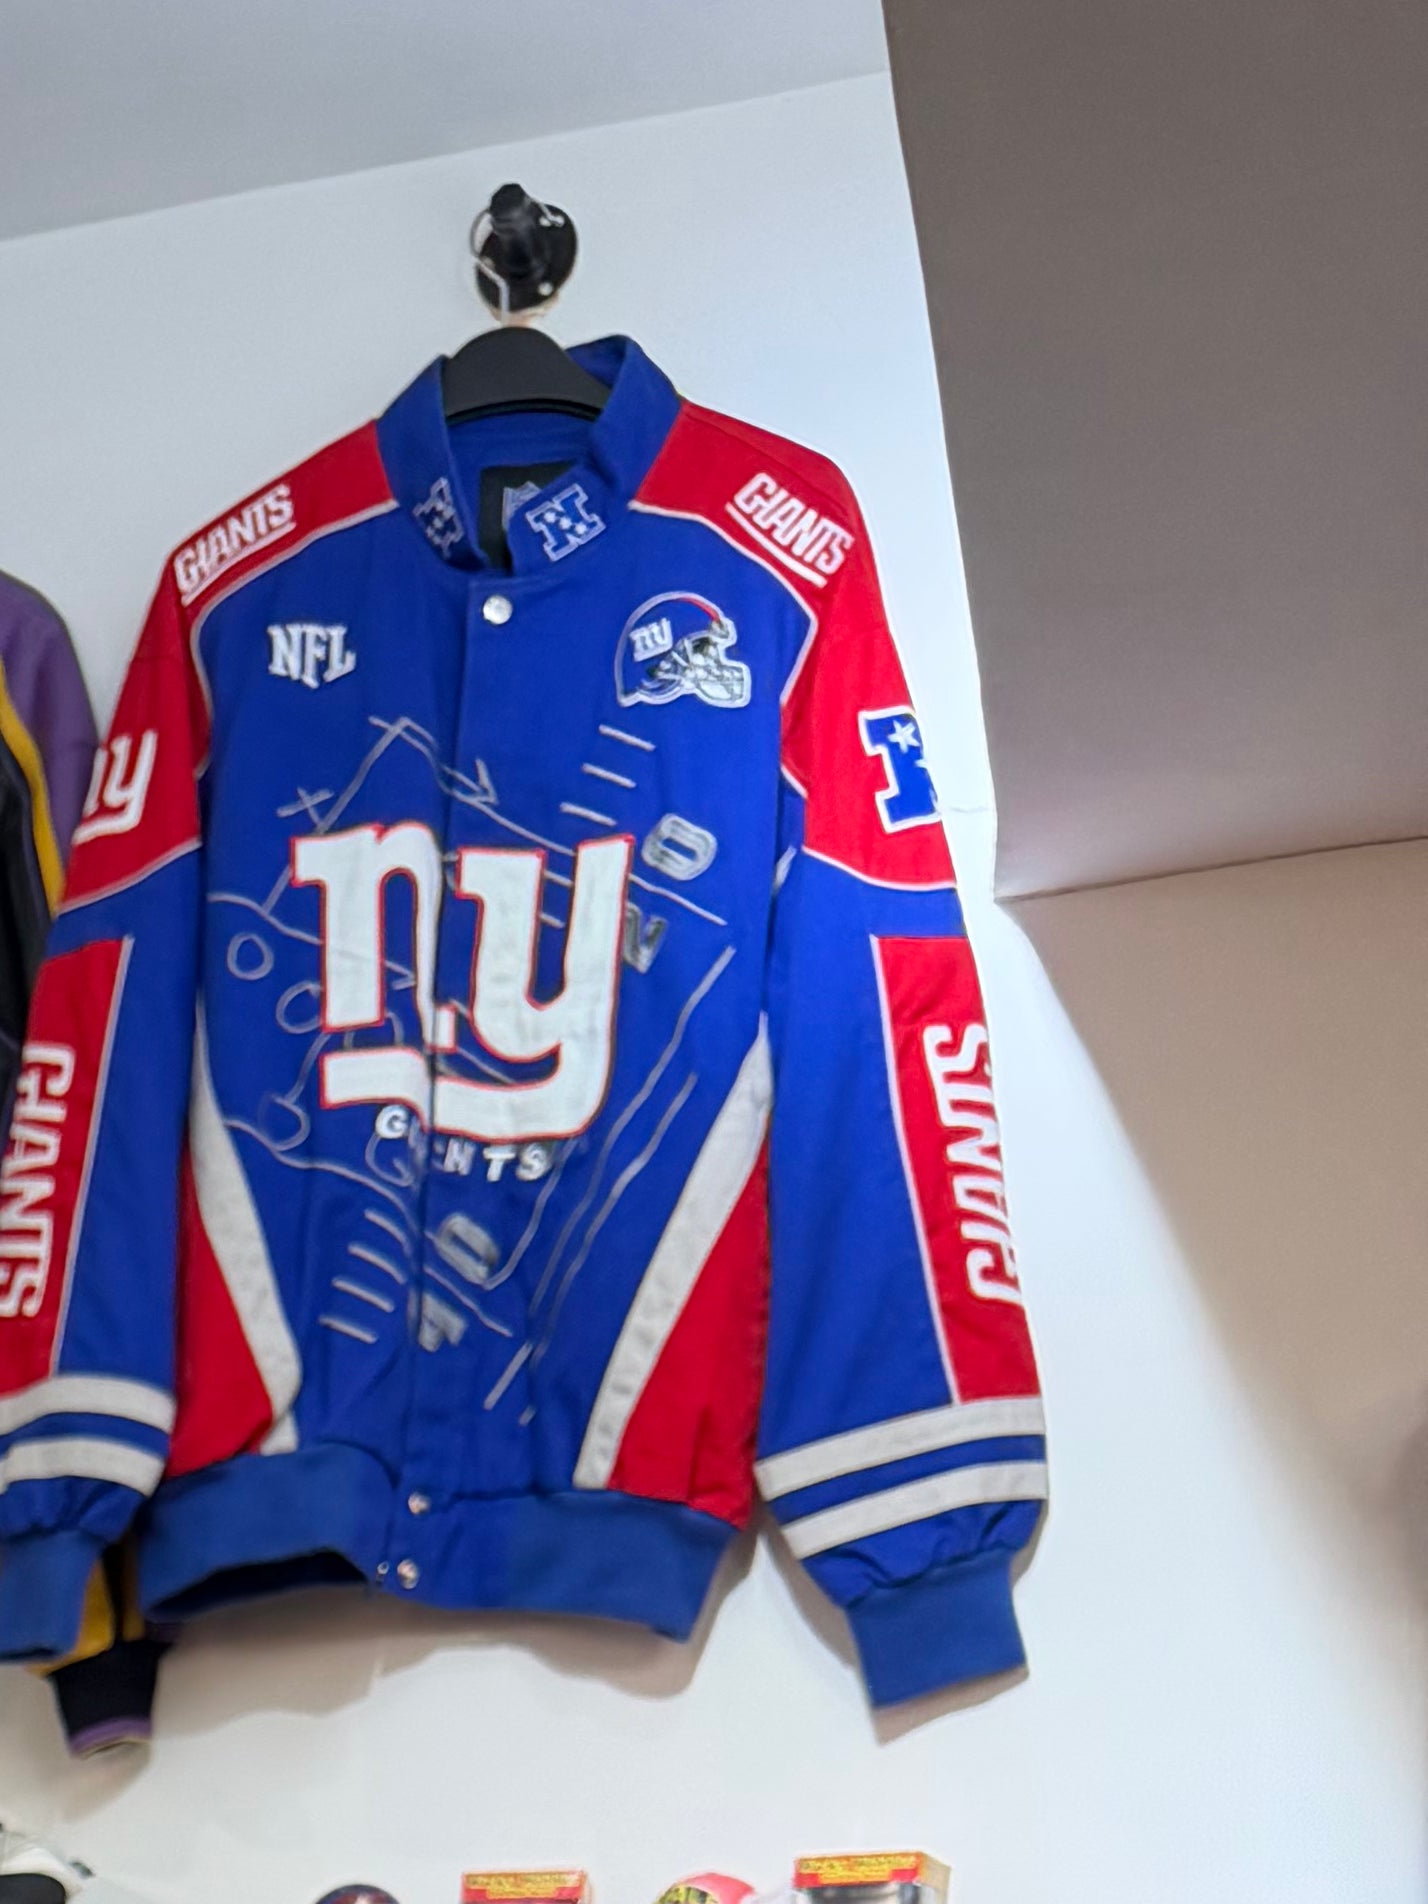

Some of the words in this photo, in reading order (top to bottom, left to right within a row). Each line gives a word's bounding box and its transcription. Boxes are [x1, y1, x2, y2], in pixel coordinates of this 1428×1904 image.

[173, 484, 296, 598] GIANTS
[733, 472, 855, 576] GIANTS
[266, 622, 356, 691] NFL
[290, 821, 634, 1143] ny
[375, 1104, 552, 1182] GNTS
[922, 1023, 1022, 1306] GIANTS
